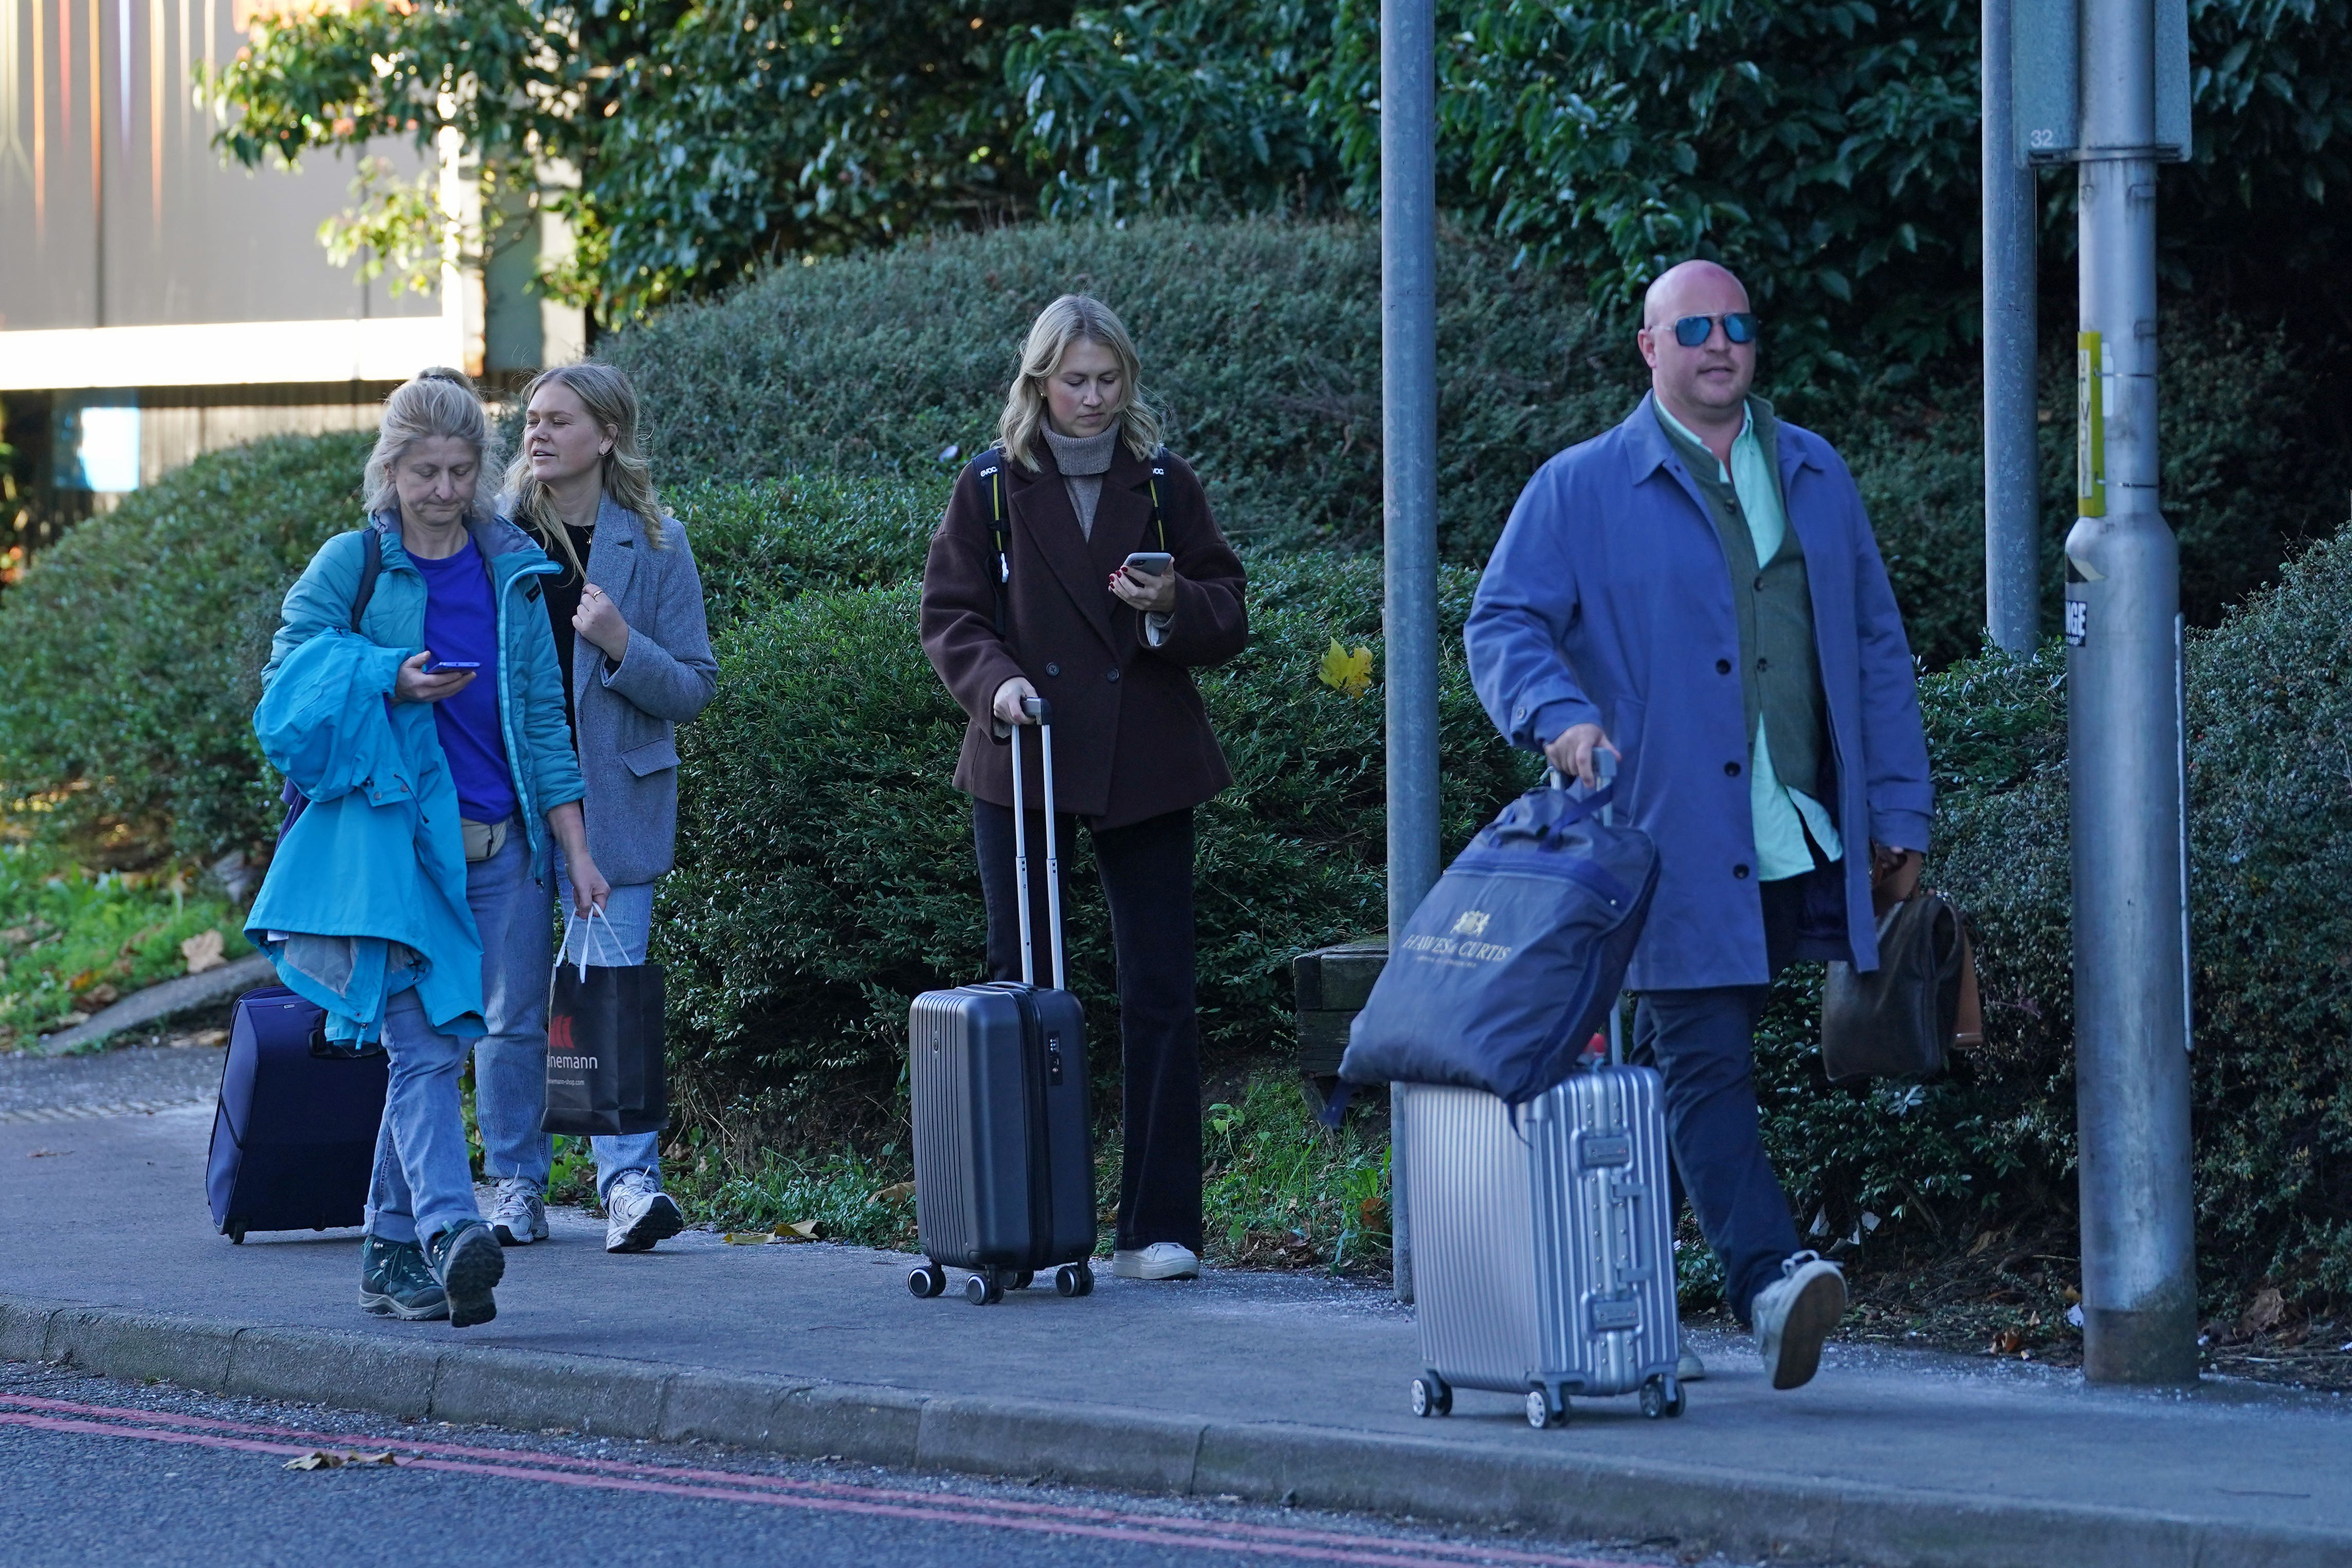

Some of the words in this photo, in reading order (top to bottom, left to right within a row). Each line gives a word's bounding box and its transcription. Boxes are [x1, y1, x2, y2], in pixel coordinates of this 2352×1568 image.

[2030, 129, 2054, 148] 32
[980, 466, 997, 477] evoc
[2065, 601, 2087, 637] NGE
[1401, 934, 1453, 955] HAWES
[1458, 940, 1512, 962] CURTIS
